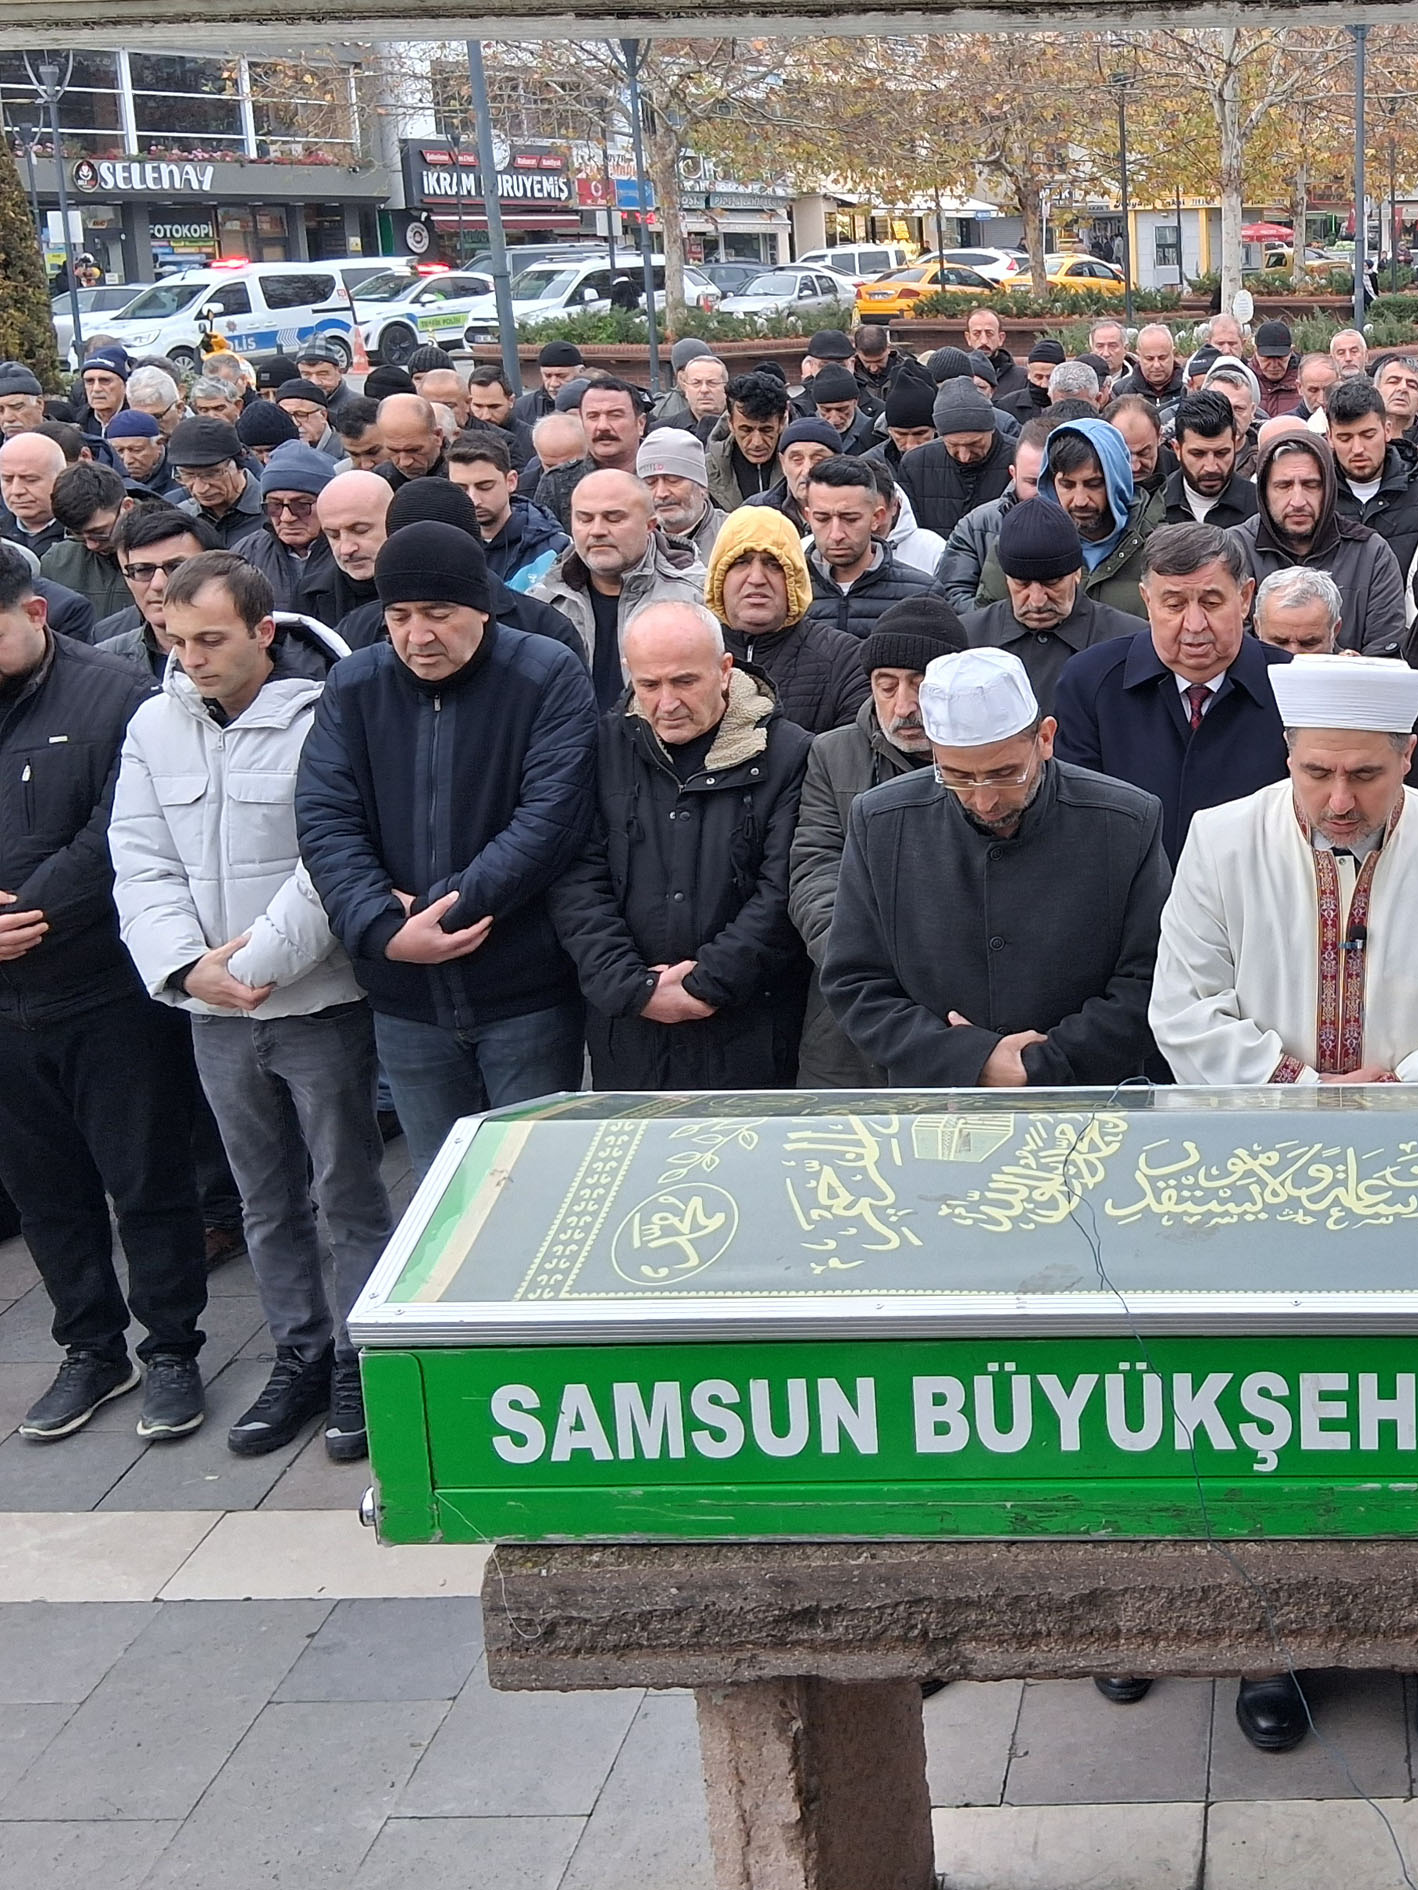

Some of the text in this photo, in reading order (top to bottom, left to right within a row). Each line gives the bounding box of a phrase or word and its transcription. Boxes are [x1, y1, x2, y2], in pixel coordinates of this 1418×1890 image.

[100, 162, 213, 190] SELENAY
[422, 171, 475, 197] İKRAM
[491, 1376, 879, 1464] SAMSUN
